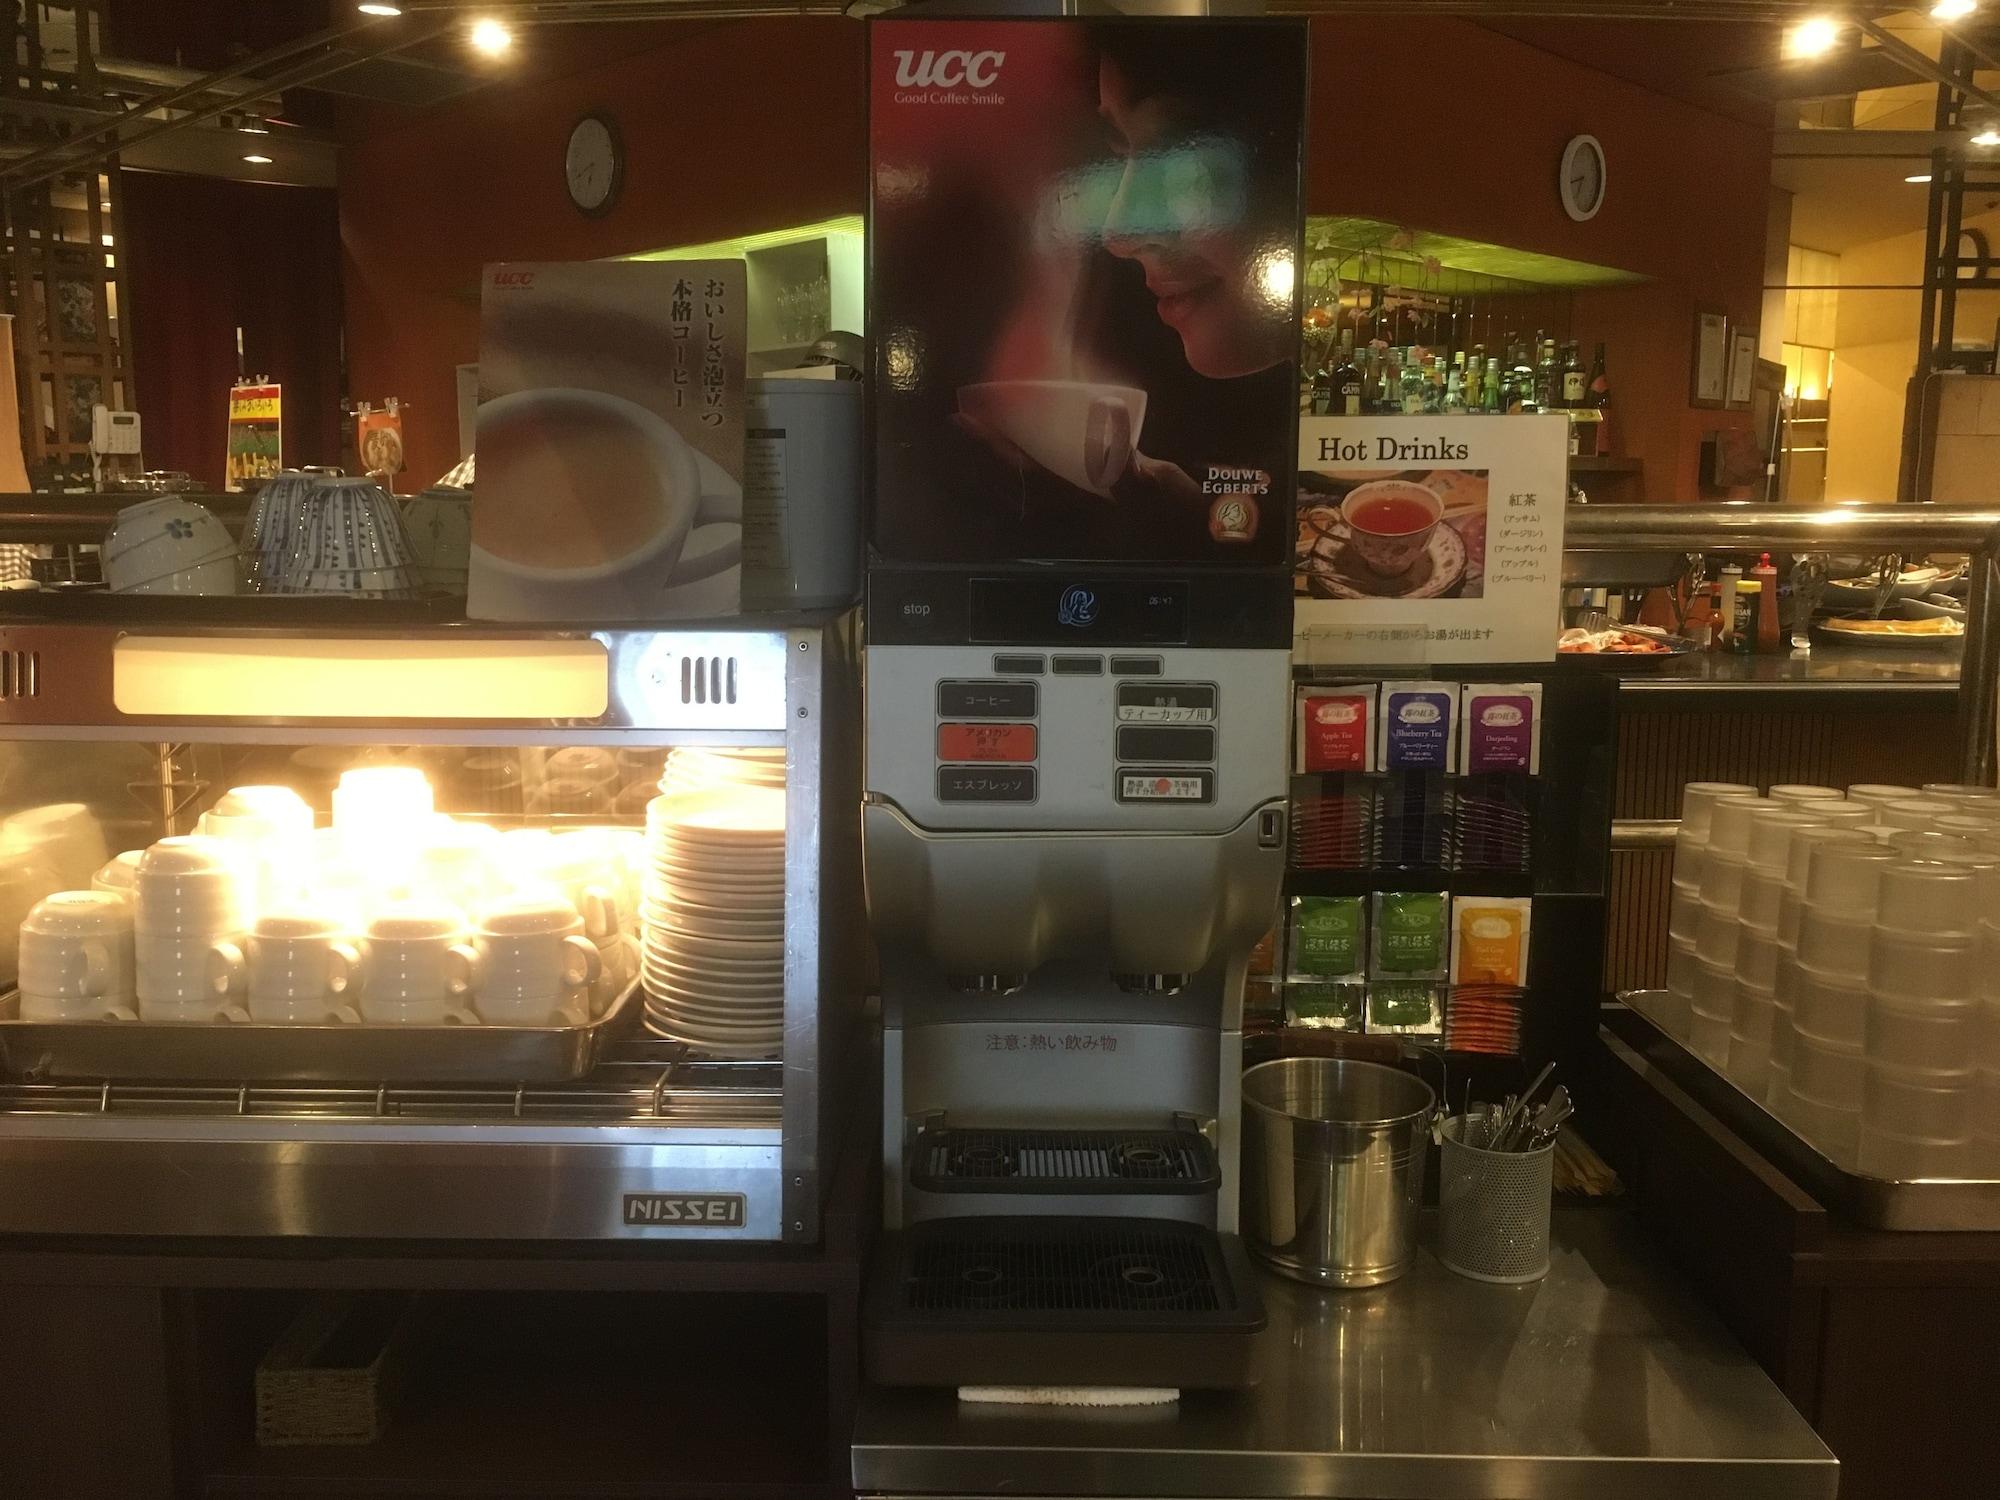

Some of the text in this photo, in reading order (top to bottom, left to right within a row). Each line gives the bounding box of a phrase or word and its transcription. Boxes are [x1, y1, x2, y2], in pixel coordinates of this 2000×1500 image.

[894, 91, 1005, 104] Good Coffee Smile
[670, 279, 693, 408] 本格コーヒー
[701, 279, 725, 427] おいしさ泡立つ
[1317, 436, 1469, 461] Hot Drinks
[1208, 467, 1264, 481] DOUWE
[1202, 481, 1269, 495] EGBERTS
[1508, 492, 1537, 507] 紅茶
[903, 603, 931, 617] stop
[965, 696, 1012, 707] コーヒー
[1396, 729, 1443, 740] Blueberry Tea
[1485, 735, 1518, 744] Darjeeling
[953, 779, 1022, 791] エスプレッソ
[629, 1200, 738, 1221] NISSEI
